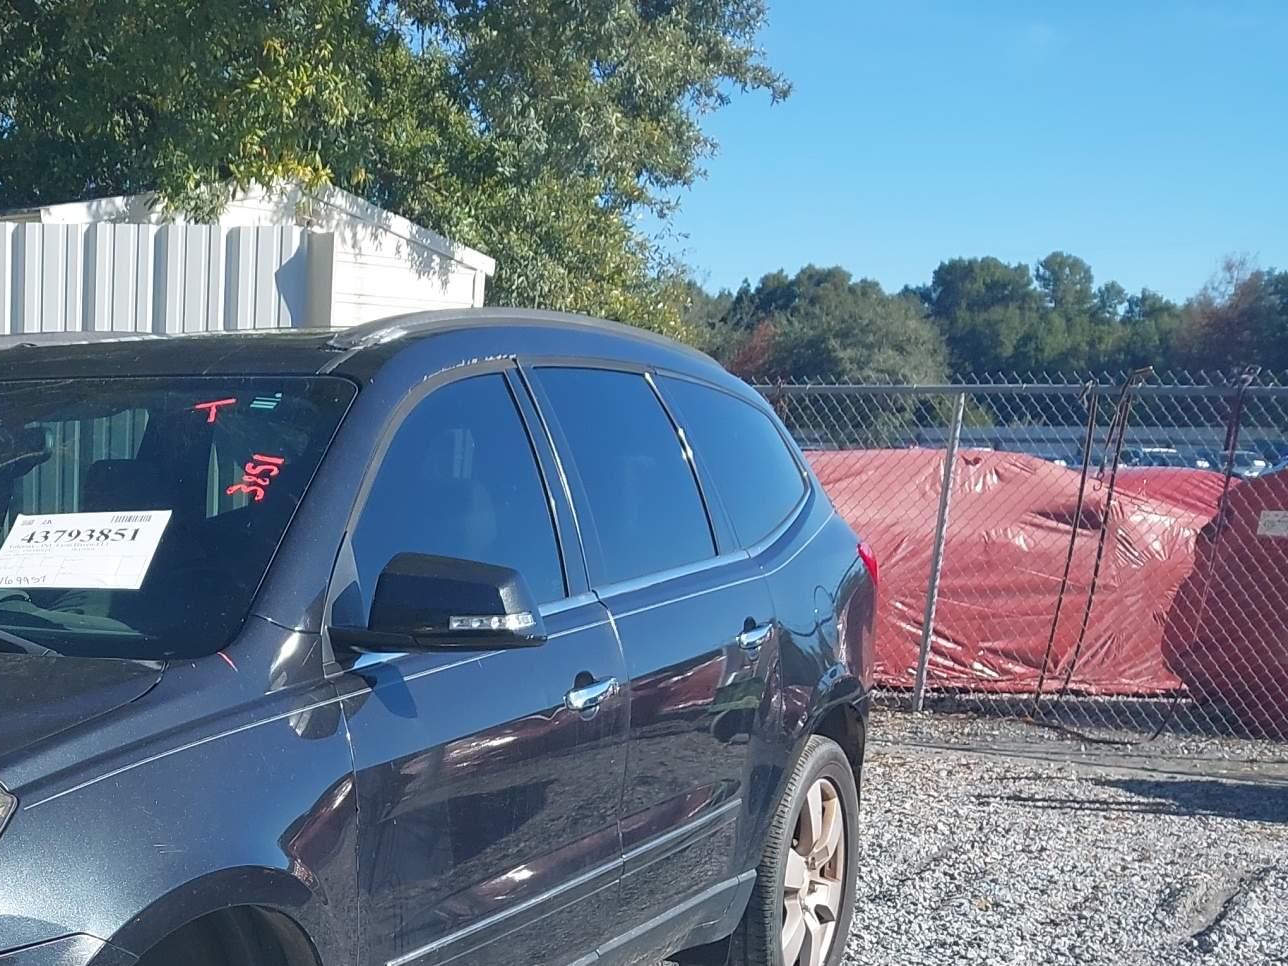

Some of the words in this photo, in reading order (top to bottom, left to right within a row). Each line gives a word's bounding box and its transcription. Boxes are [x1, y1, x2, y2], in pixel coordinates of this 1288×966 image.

[194, 397, 238, 423] T
[226, 454, 285, 502] 3851
[21, 527, 141, 544] 43793851
